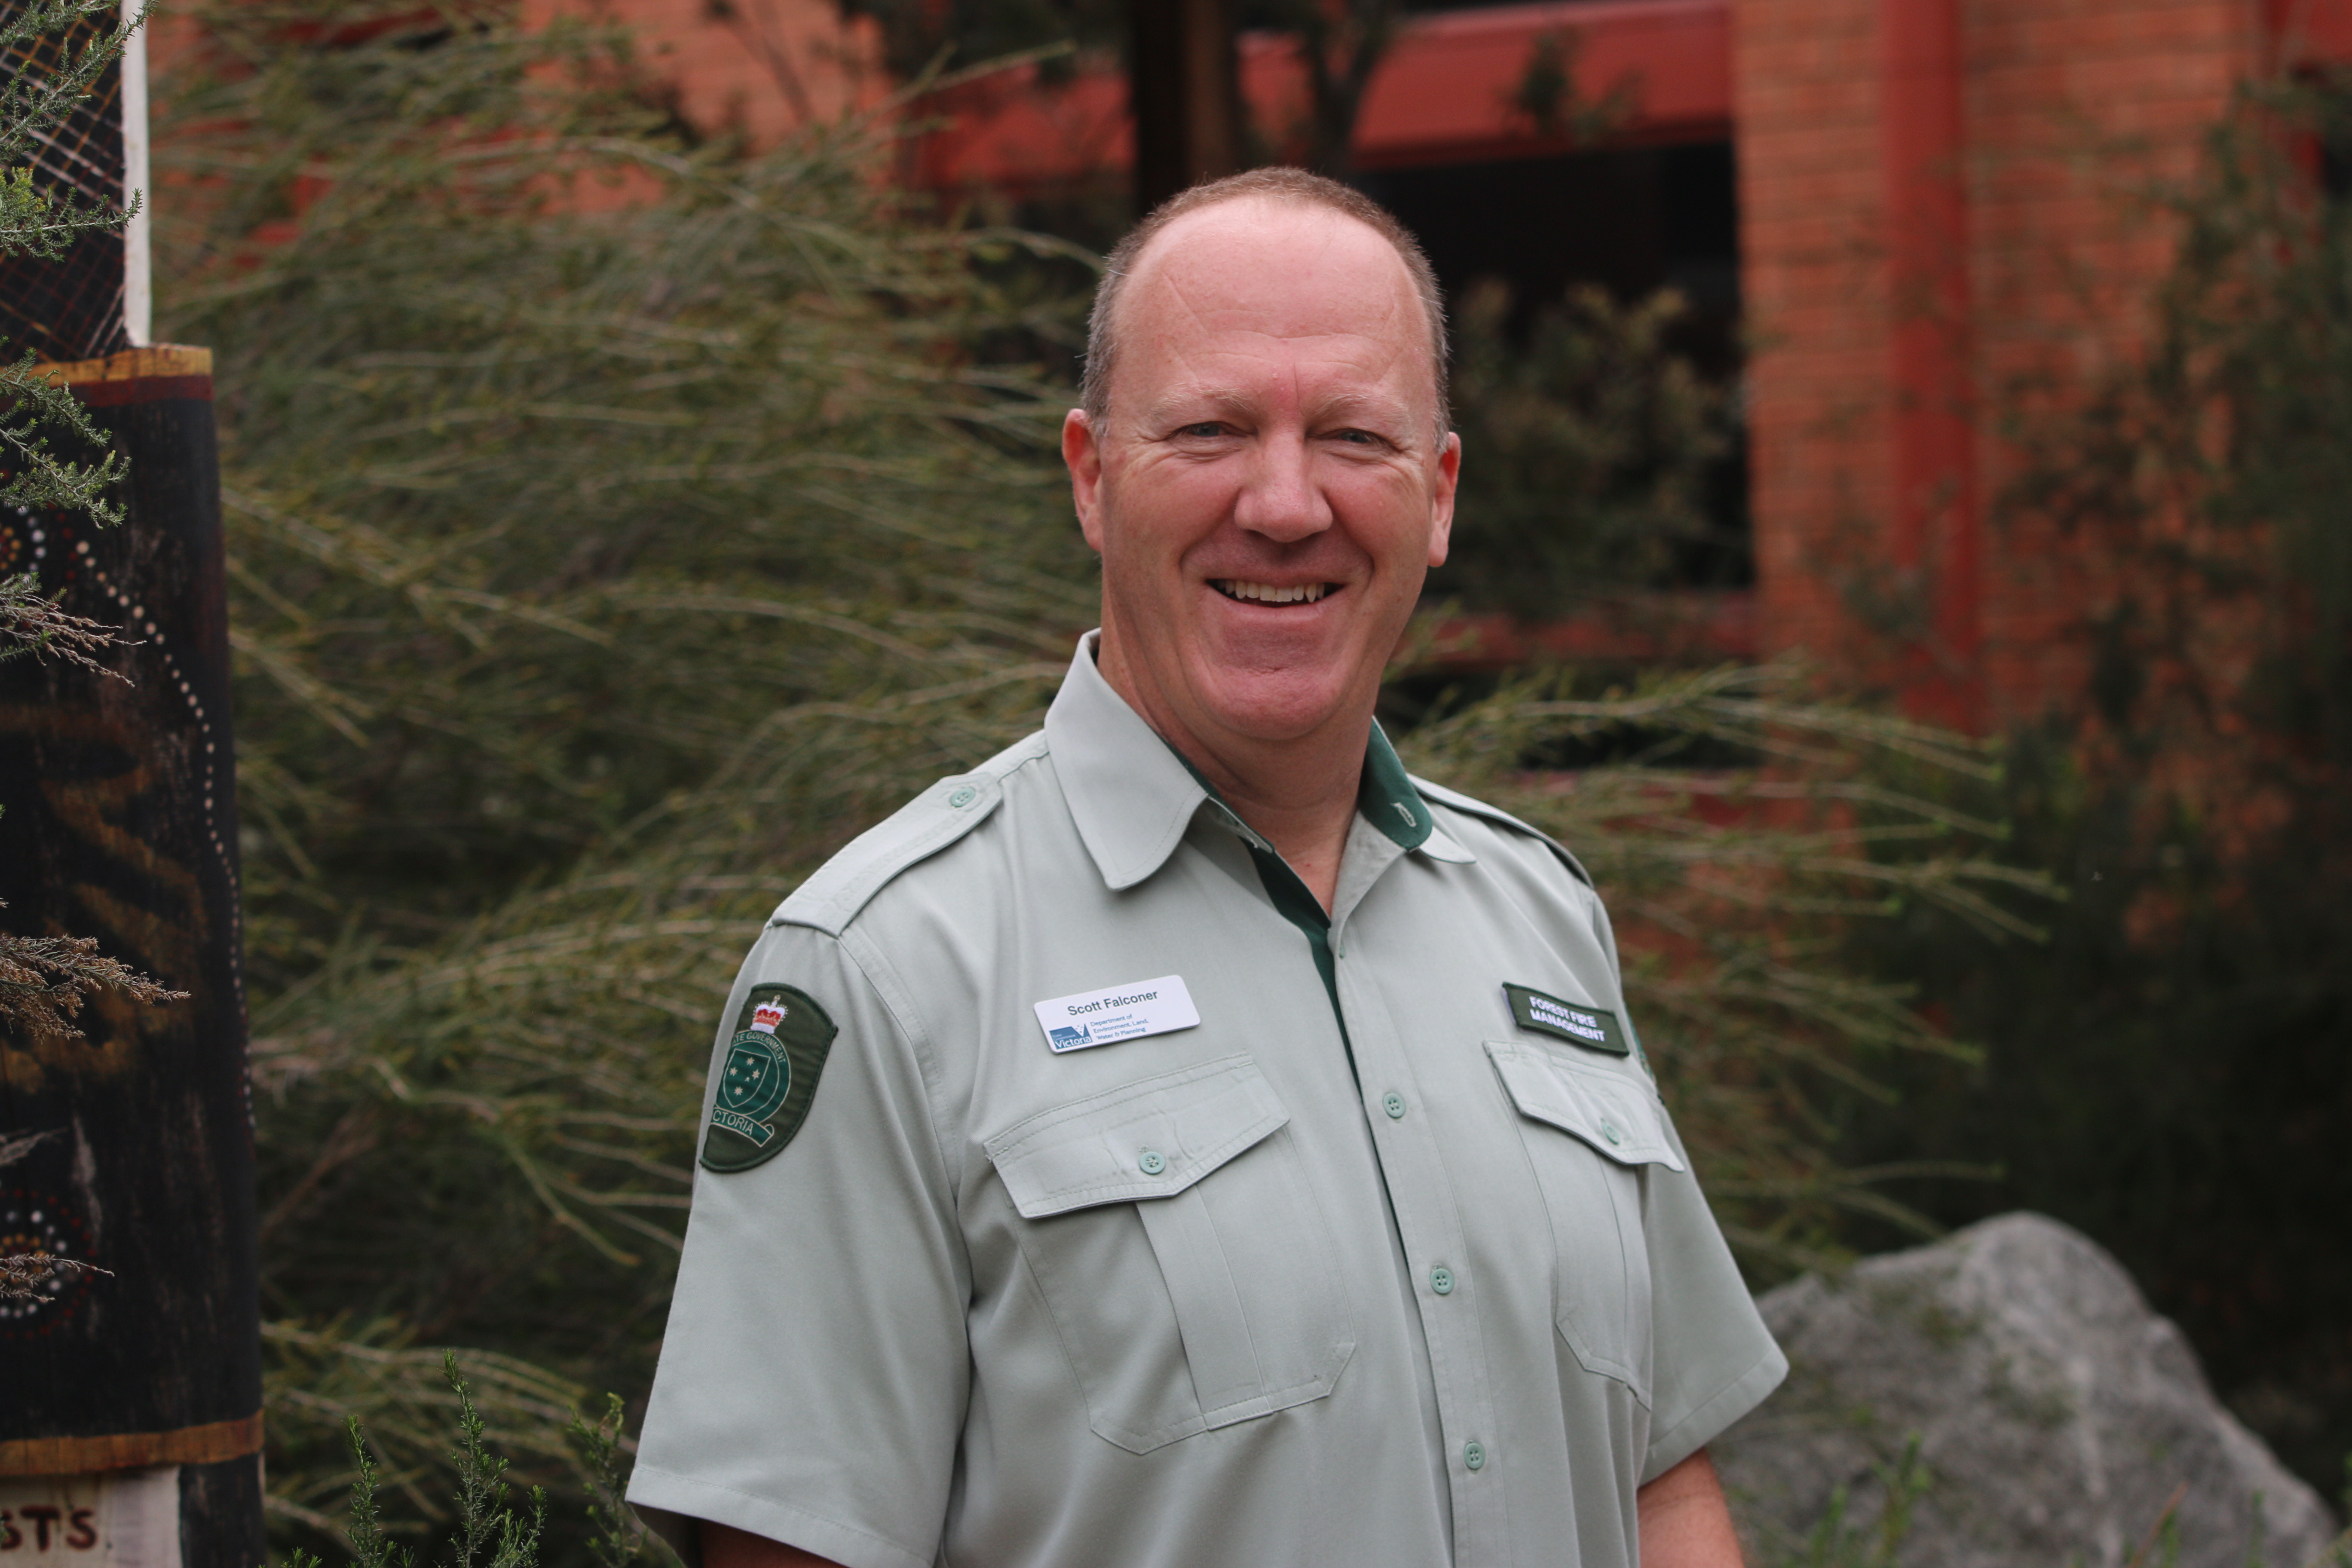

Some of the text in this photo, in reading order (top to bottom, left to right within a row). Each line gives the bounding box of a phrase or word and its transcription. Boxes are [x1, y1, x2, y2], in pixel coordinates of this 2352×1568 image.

[1067, 991, 1158, 1016] Scott Falconer
[1529, 995, 1598, 1028] FOREST FIRE
[1090, 1016, 1126, 1026] Department
[1093, 1023, 1132, 1033] Environment,
[1529, 1008, 1605, 1042] MANAGEMENT
[1120, 1027, 1146, 1035] Planning
[746, 1032, 786, 1063] GOVERNMENT
[1054, 1036, 1092, 1048] Victoria
